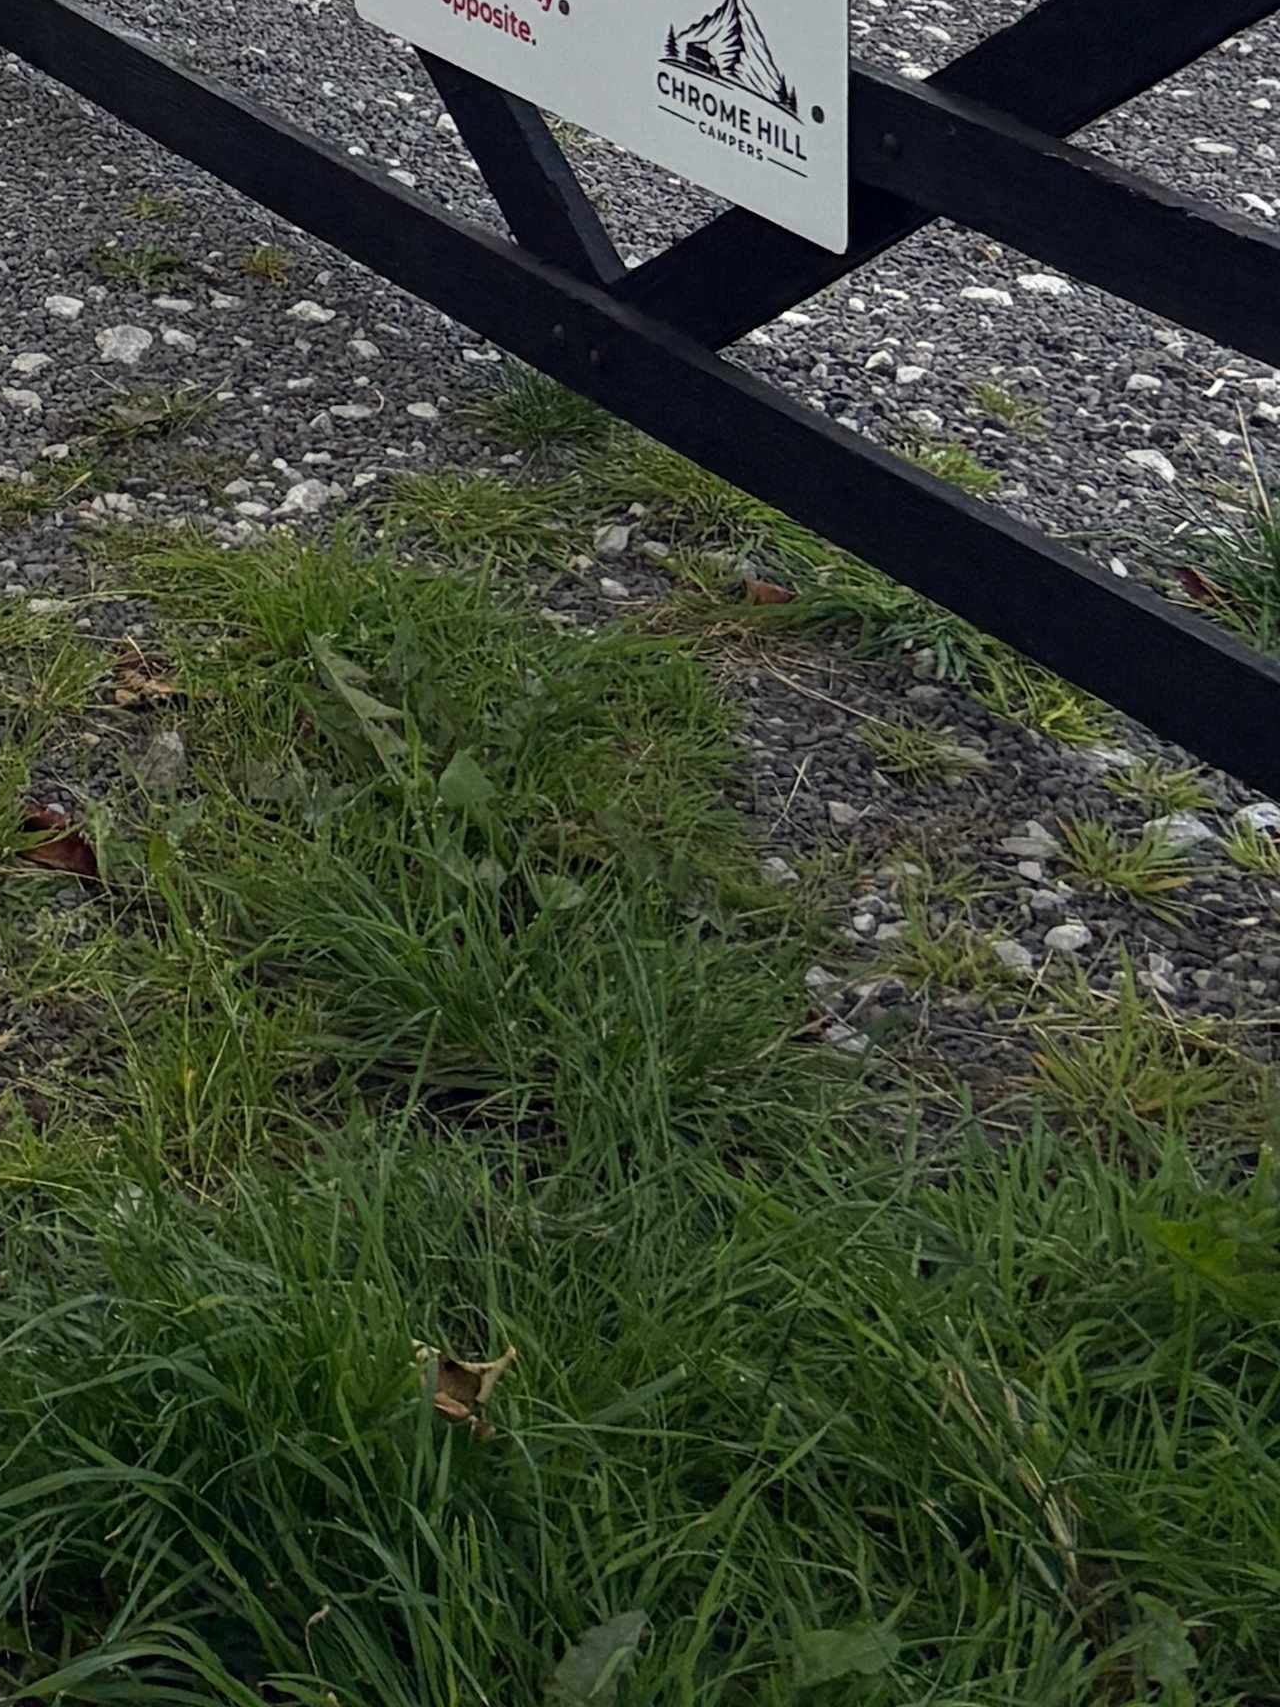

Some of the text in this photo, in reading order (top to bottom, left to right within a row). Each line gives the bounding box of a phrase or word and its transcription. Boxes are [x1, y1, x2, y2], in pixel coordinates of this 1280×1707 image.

[657, 72, 807, 161] CHROME HILL
[698, 121, 764, 161] CAMPERS
